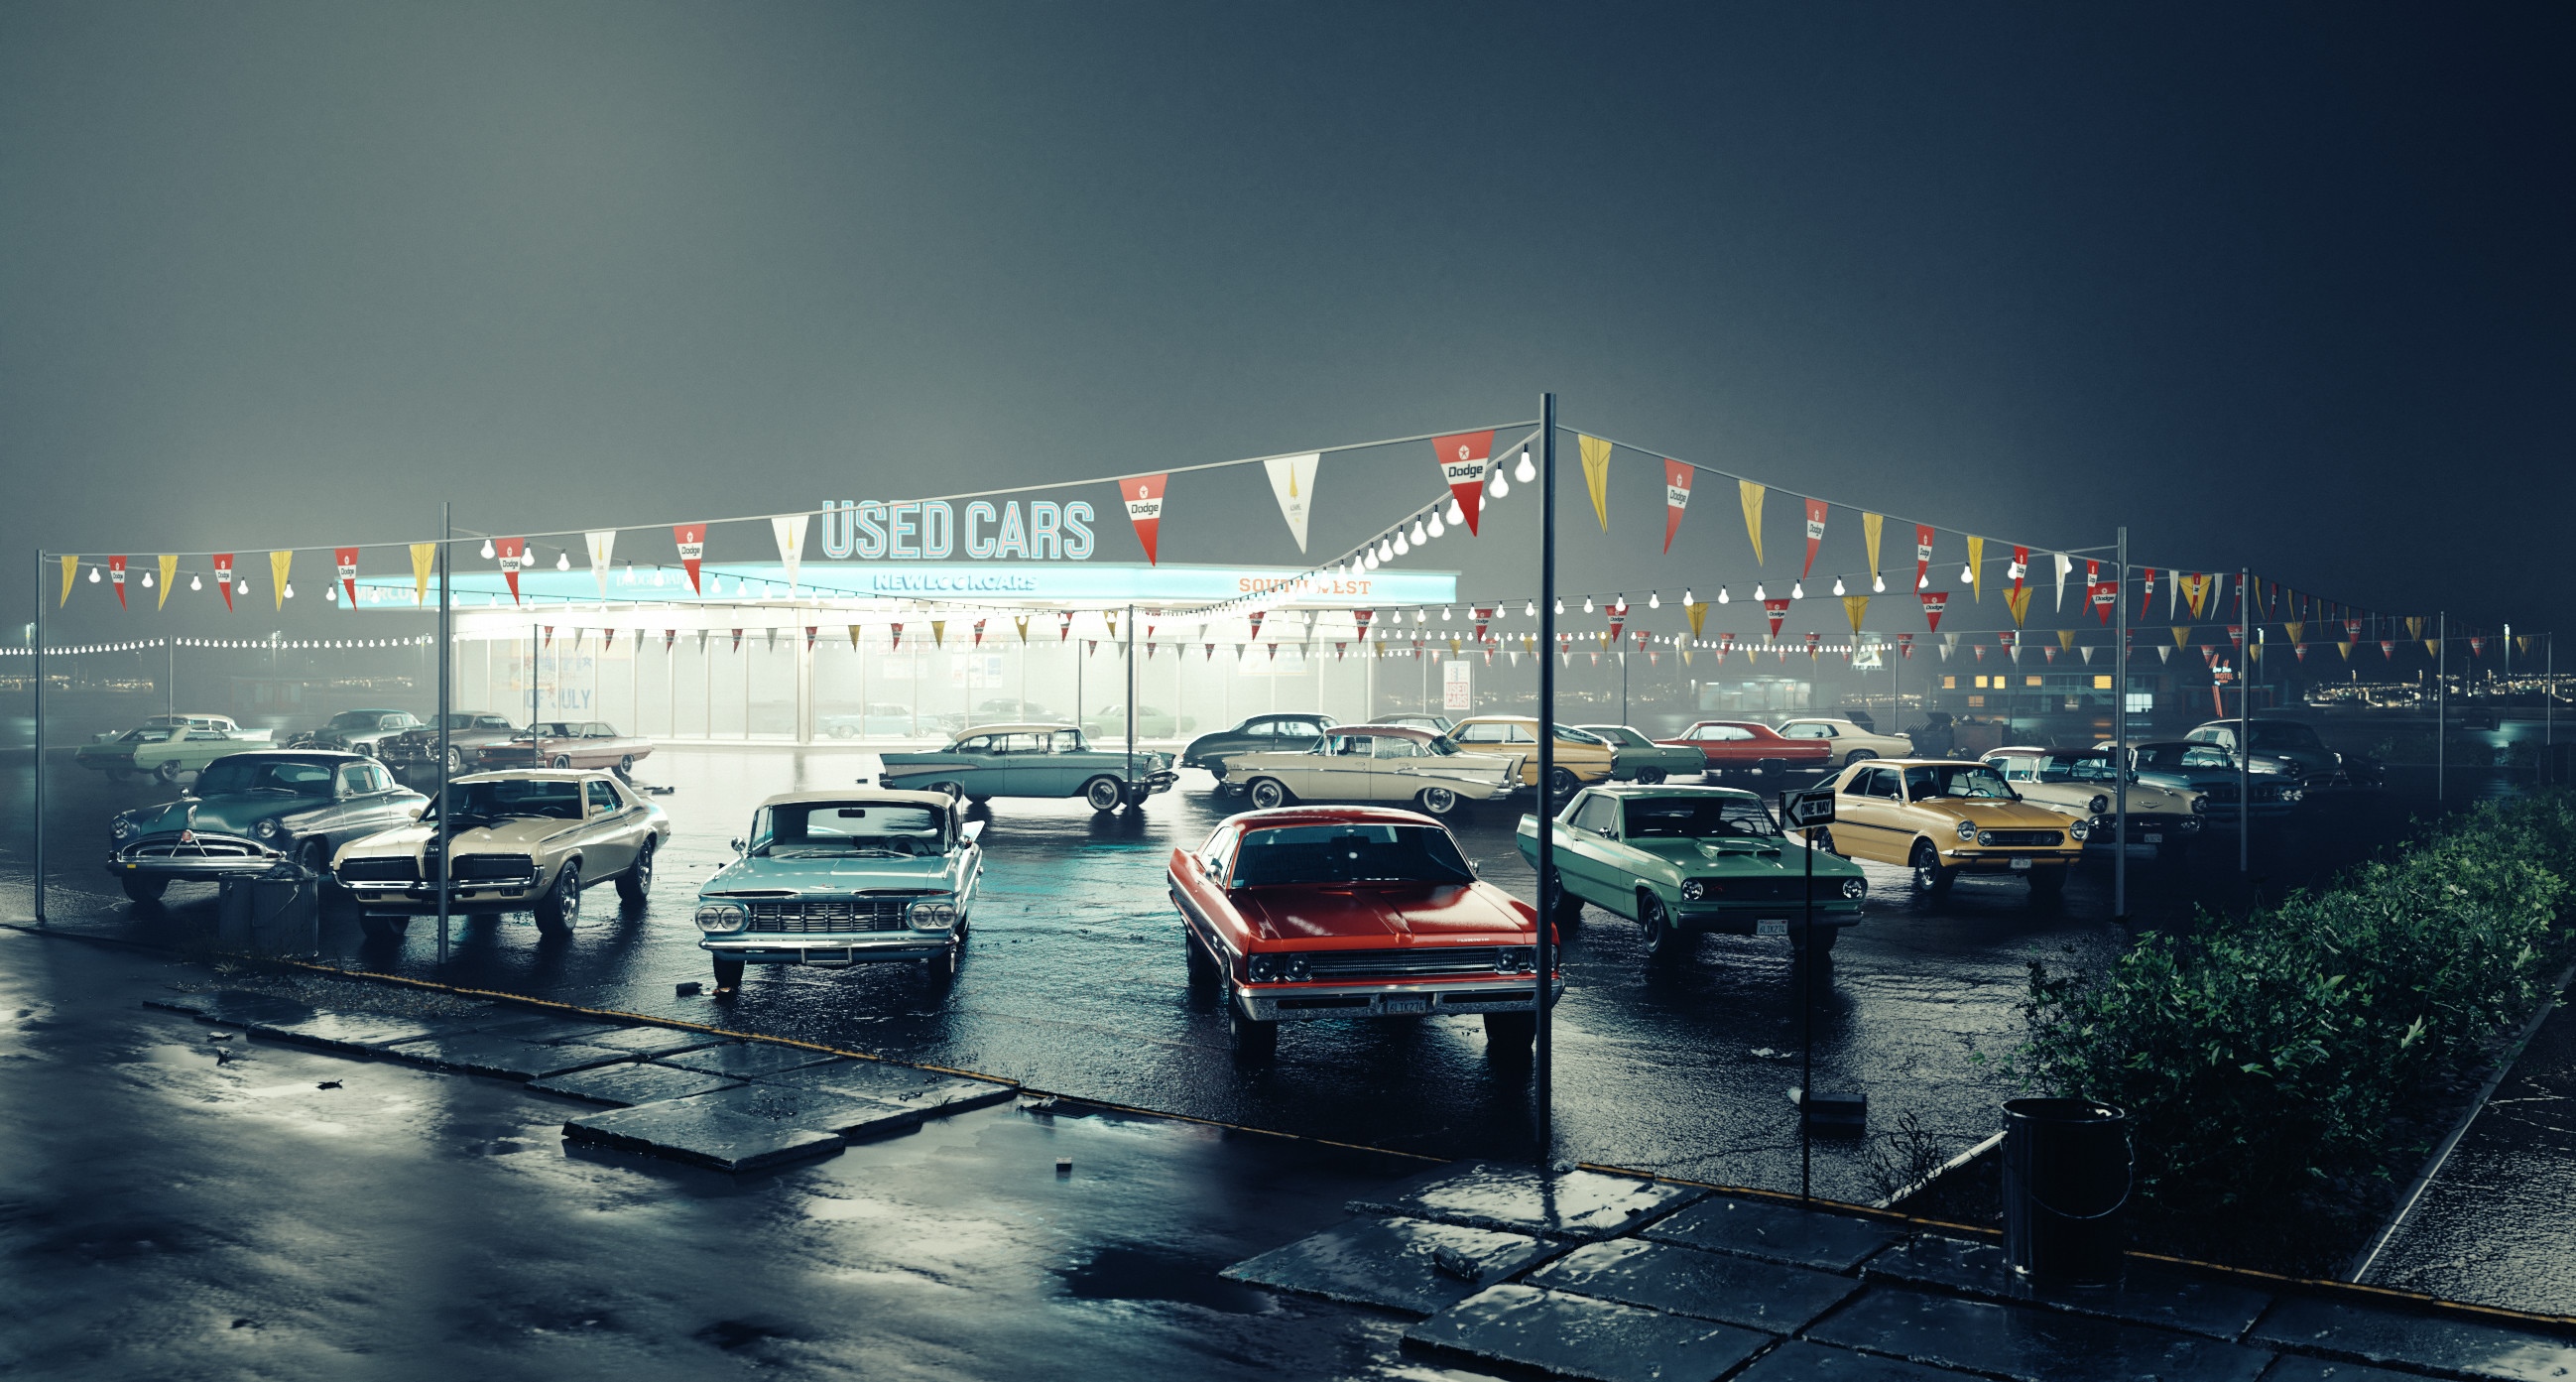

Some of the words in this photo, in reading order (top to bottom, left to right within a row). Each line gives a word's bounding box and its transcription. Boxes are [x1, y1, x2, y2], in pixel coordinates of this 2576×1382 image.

[1449, 463, 1483, 478] Dodge
[1670, 489, 1686, 504] Dodge
[1132, 502, 1159, 515] Dodge
[821, 500, 953, 559] USED
[965, 500, 1095, 560] CARS
[1809, 523, 1822, 536] Dodge
[681, 545, 700, 556] Dodge
[503, 559, 519, 568] Dodge
[218, 571, 229, 580] Dodge
[341, 566, 355, 576] Dodge
[1239, 577, 1371, 594] SOUTEST
[1446, 683, 1468, 694] USED
[552, 688, 591, 709] ULY
[1446, 694, 1468, 706] CARS
[1801, 802, 1815, 816] ONE
[1816, 800, 1830, 814] WAY
